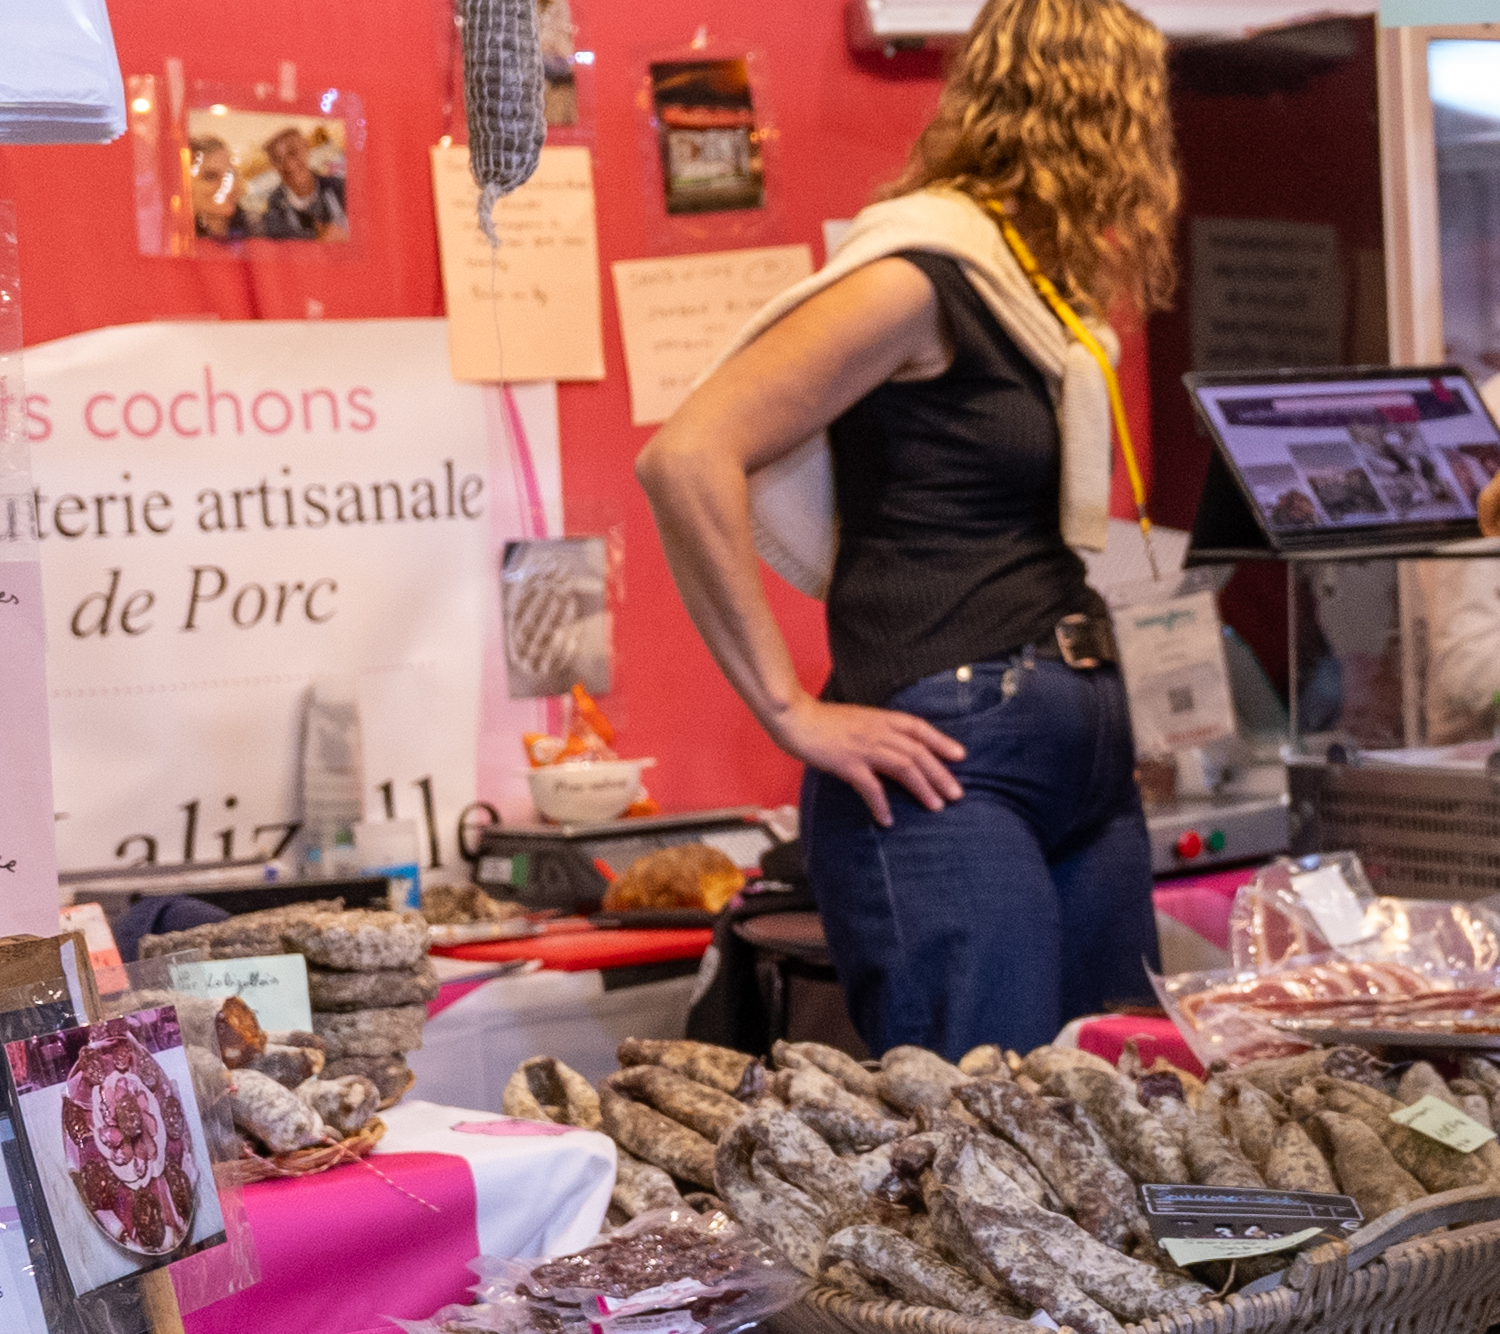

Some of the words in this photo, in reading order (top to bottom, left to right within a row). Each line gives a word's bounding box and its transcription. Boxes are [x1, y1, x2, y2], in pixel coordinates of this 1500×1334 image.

[85, 365, 377, 440] cochons
[197, 459, 485, 530] artisanale
[70, 569, 158, 640] de
[179, 565, 338, 631] Porc
